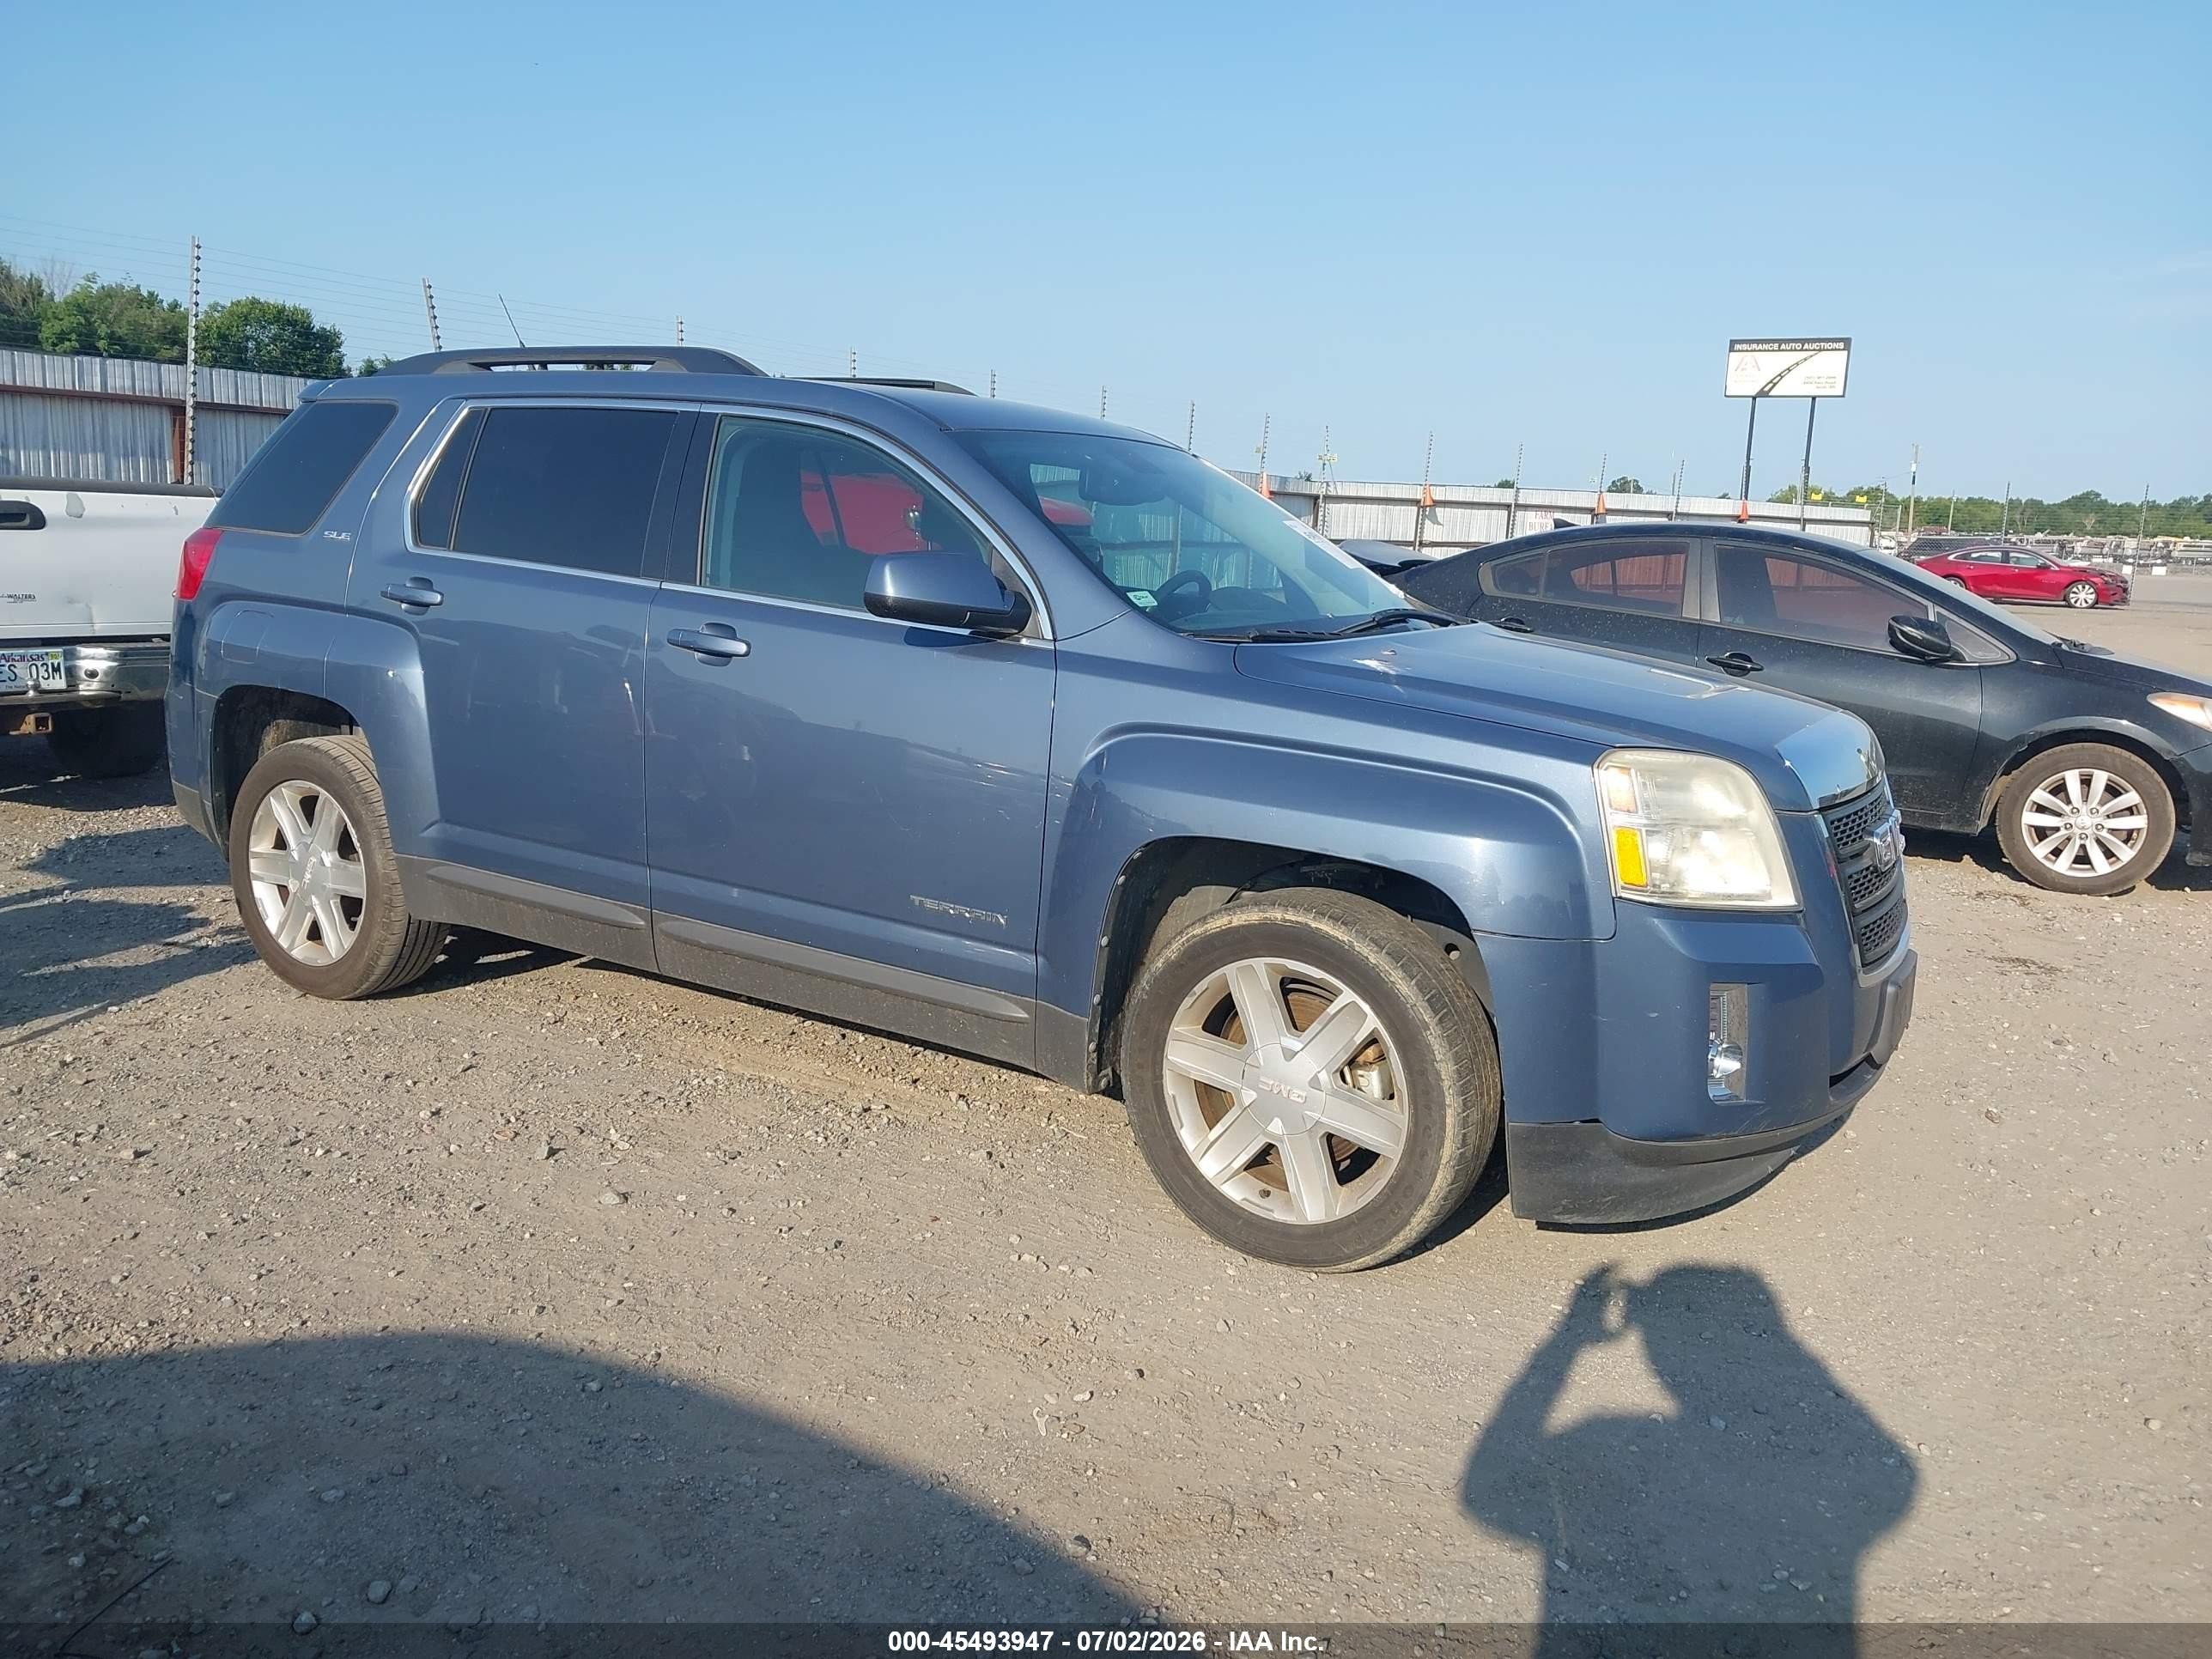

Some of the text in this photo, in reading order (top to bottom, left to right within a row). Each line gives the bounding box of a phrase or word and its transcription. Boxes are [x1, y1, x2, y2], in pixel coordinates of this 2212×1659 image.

[1734, 343, 1779, 351] INSURANCE
[1803, 342, 1844, 350] AUCTIONS
[323, 531, 351, 541] SLE
[0, 653, 45, 663] Arkansas
[29, 662, 63, 681] 03M
[909, 894, 1009, 928] TERRAIN
[1258, 1078, 1307, 1104] GMC
